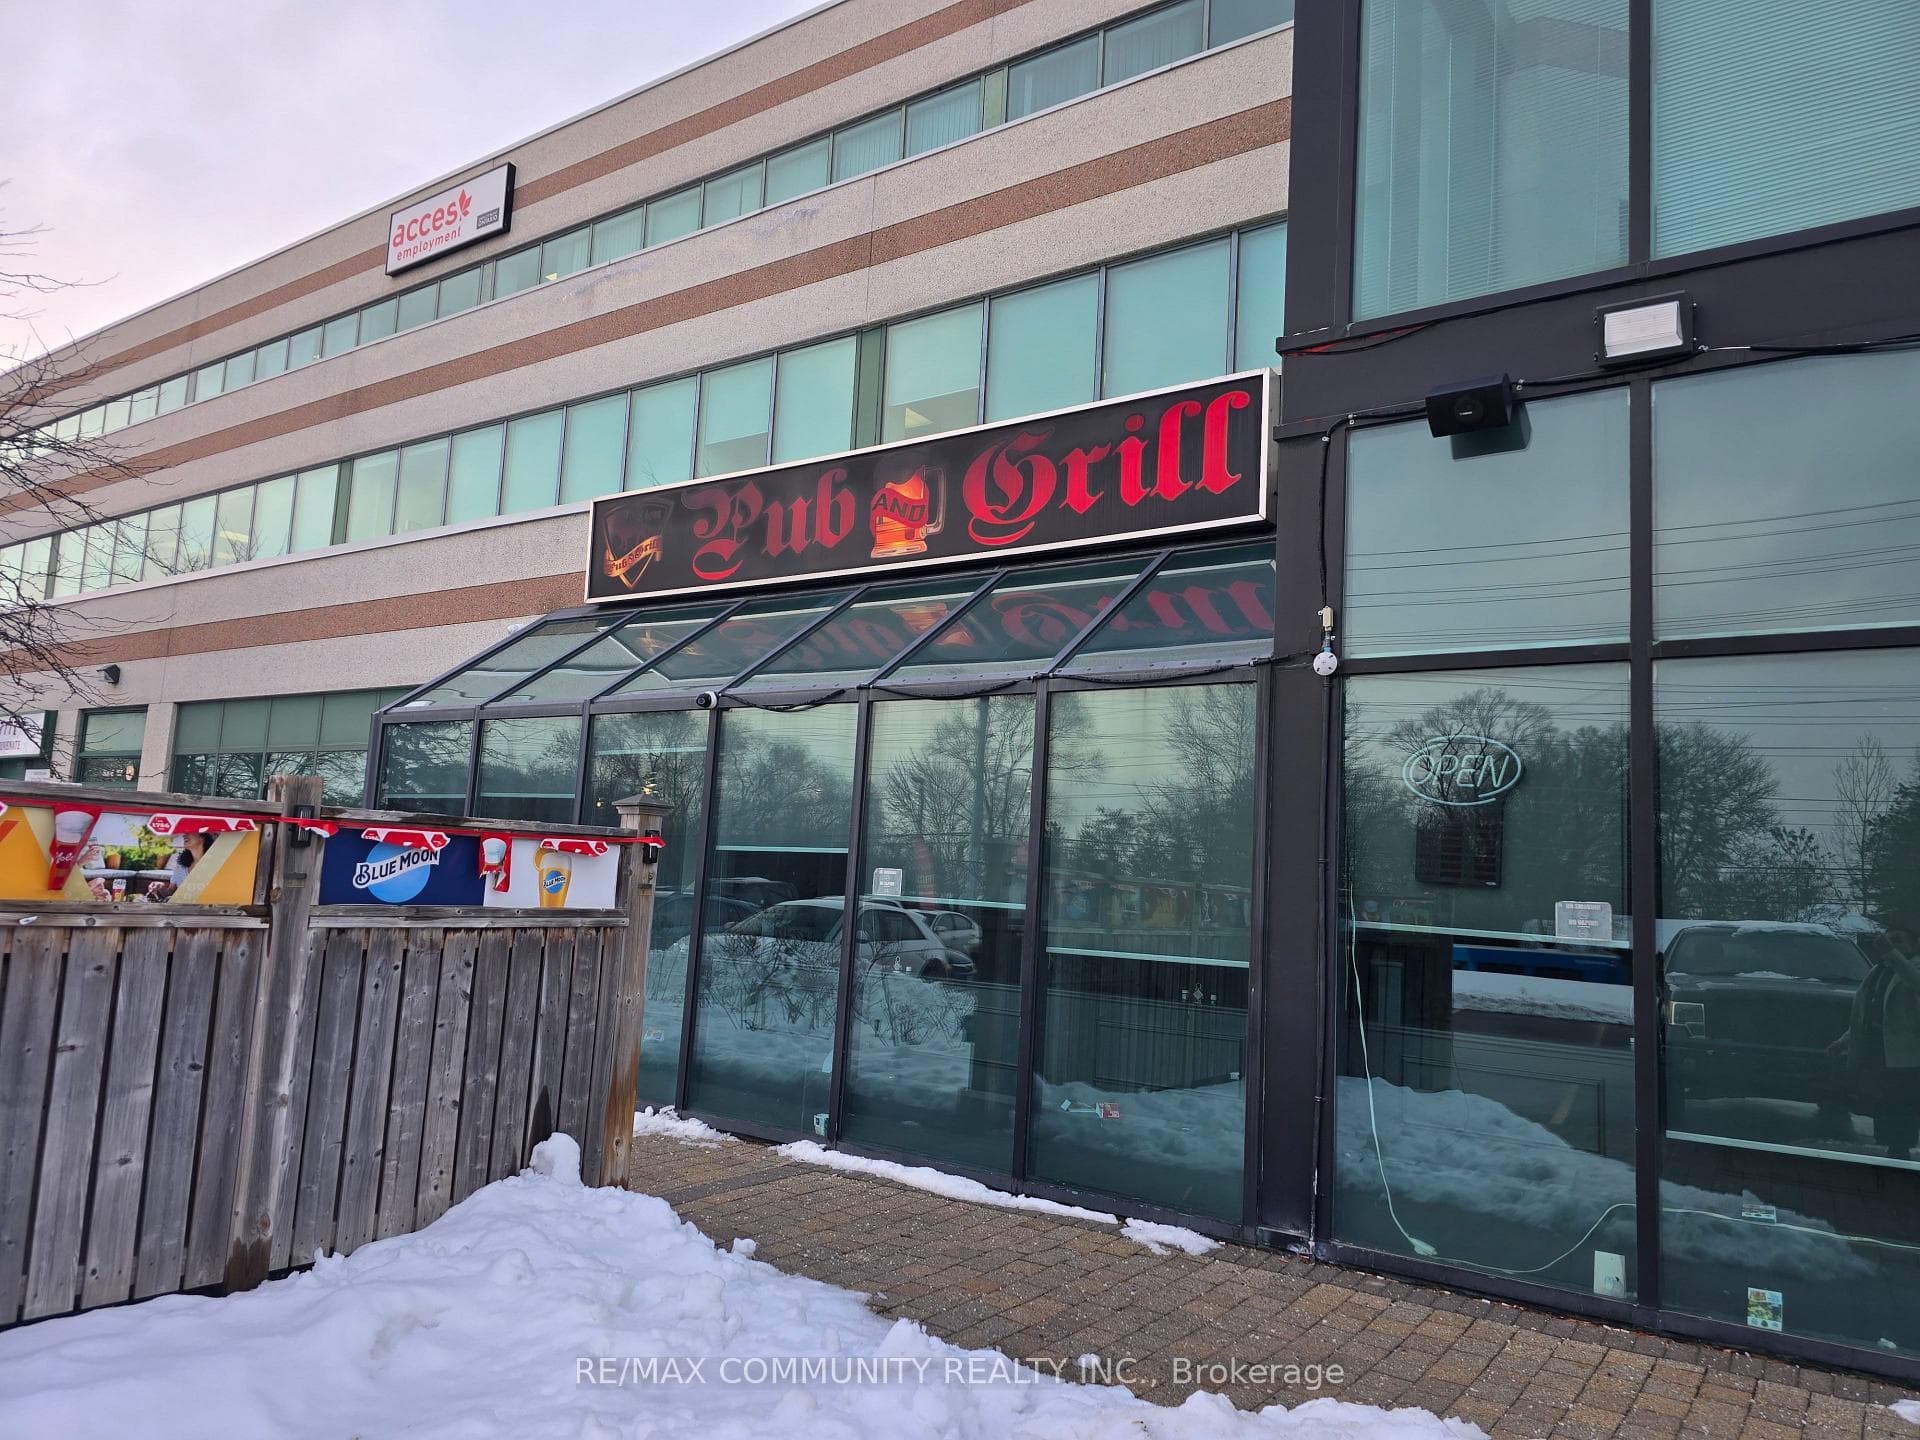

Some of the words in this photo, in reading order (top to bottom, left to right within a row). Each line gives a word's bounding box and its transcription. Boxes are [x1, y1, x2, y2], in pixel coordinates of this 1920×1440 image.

[396, 226, 462, 261] employment
[680, 468, 856, 581] Pub
[872, 492, 927, 523] AND
[962, 390, 1250, 546] Grill
[1409, 754, 1509, 788] OPEN
[354, 859, 397, 886] BLUE
[399, 849, 438, 871] MOON
